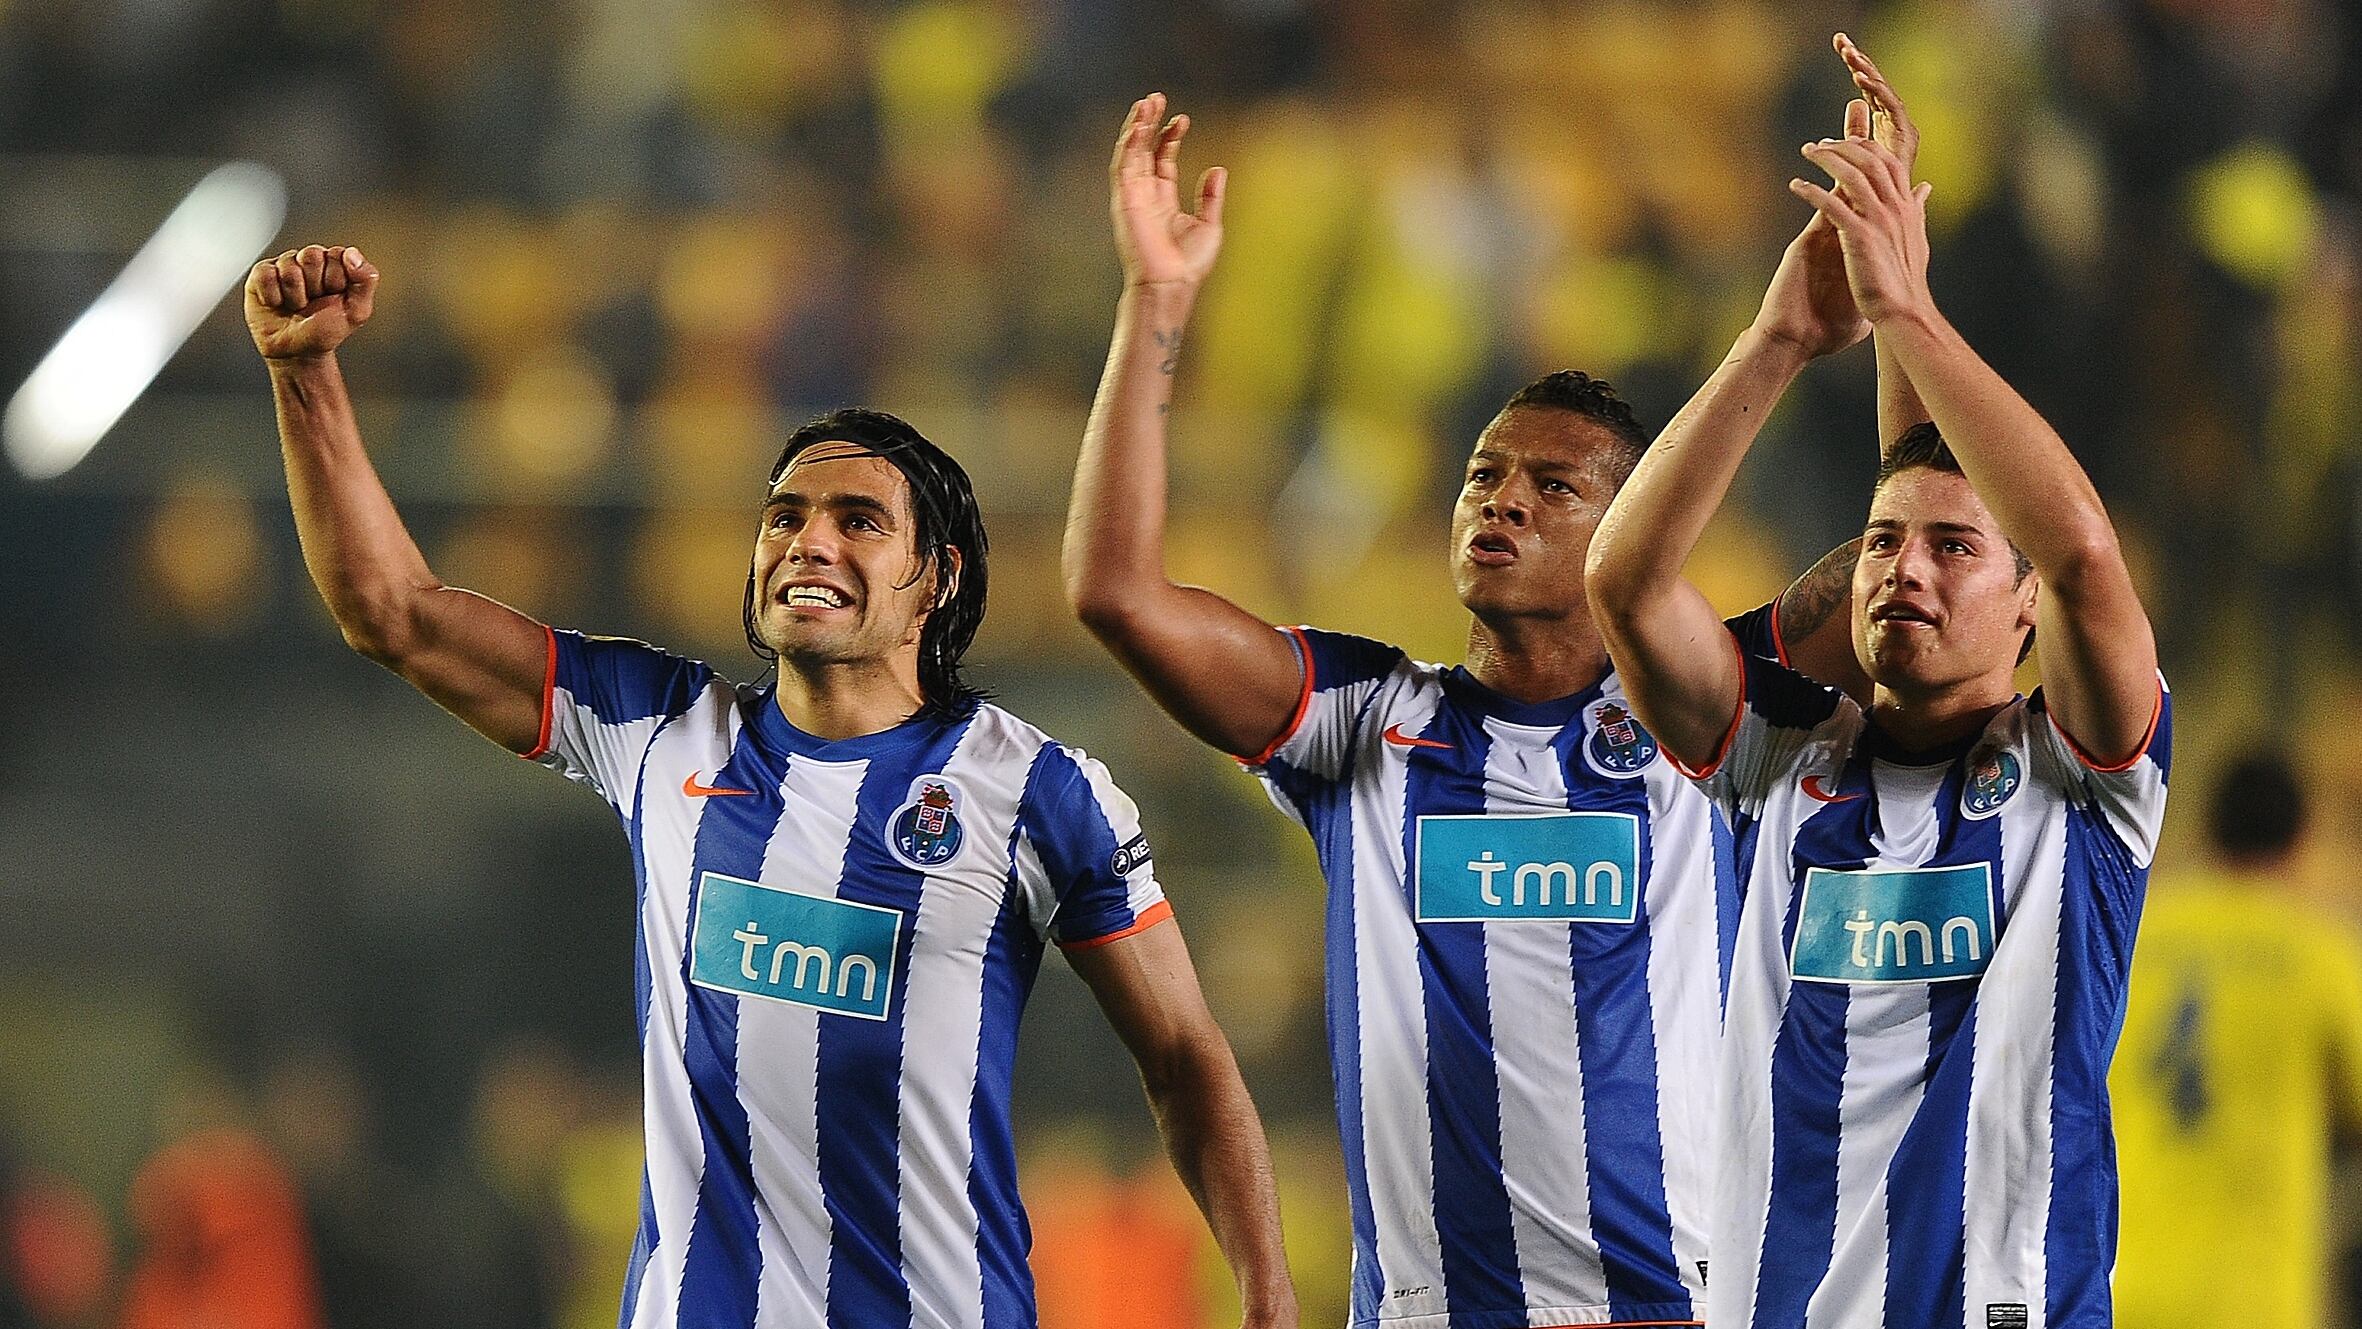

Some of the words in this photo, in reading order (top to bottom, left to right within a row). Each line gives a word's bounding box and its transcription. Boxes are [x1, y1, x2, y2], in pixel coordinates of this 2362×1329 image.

[1604, 746, 1652, 768] FCP
[1974, 778, 2015, 809] FCP
[901, 837, 949, 860] FCP
[1467, 851, 1622, 906] tmn
[1844, 910, 1981, 968] tmn
[732, 921, 877, 1001] tmn
